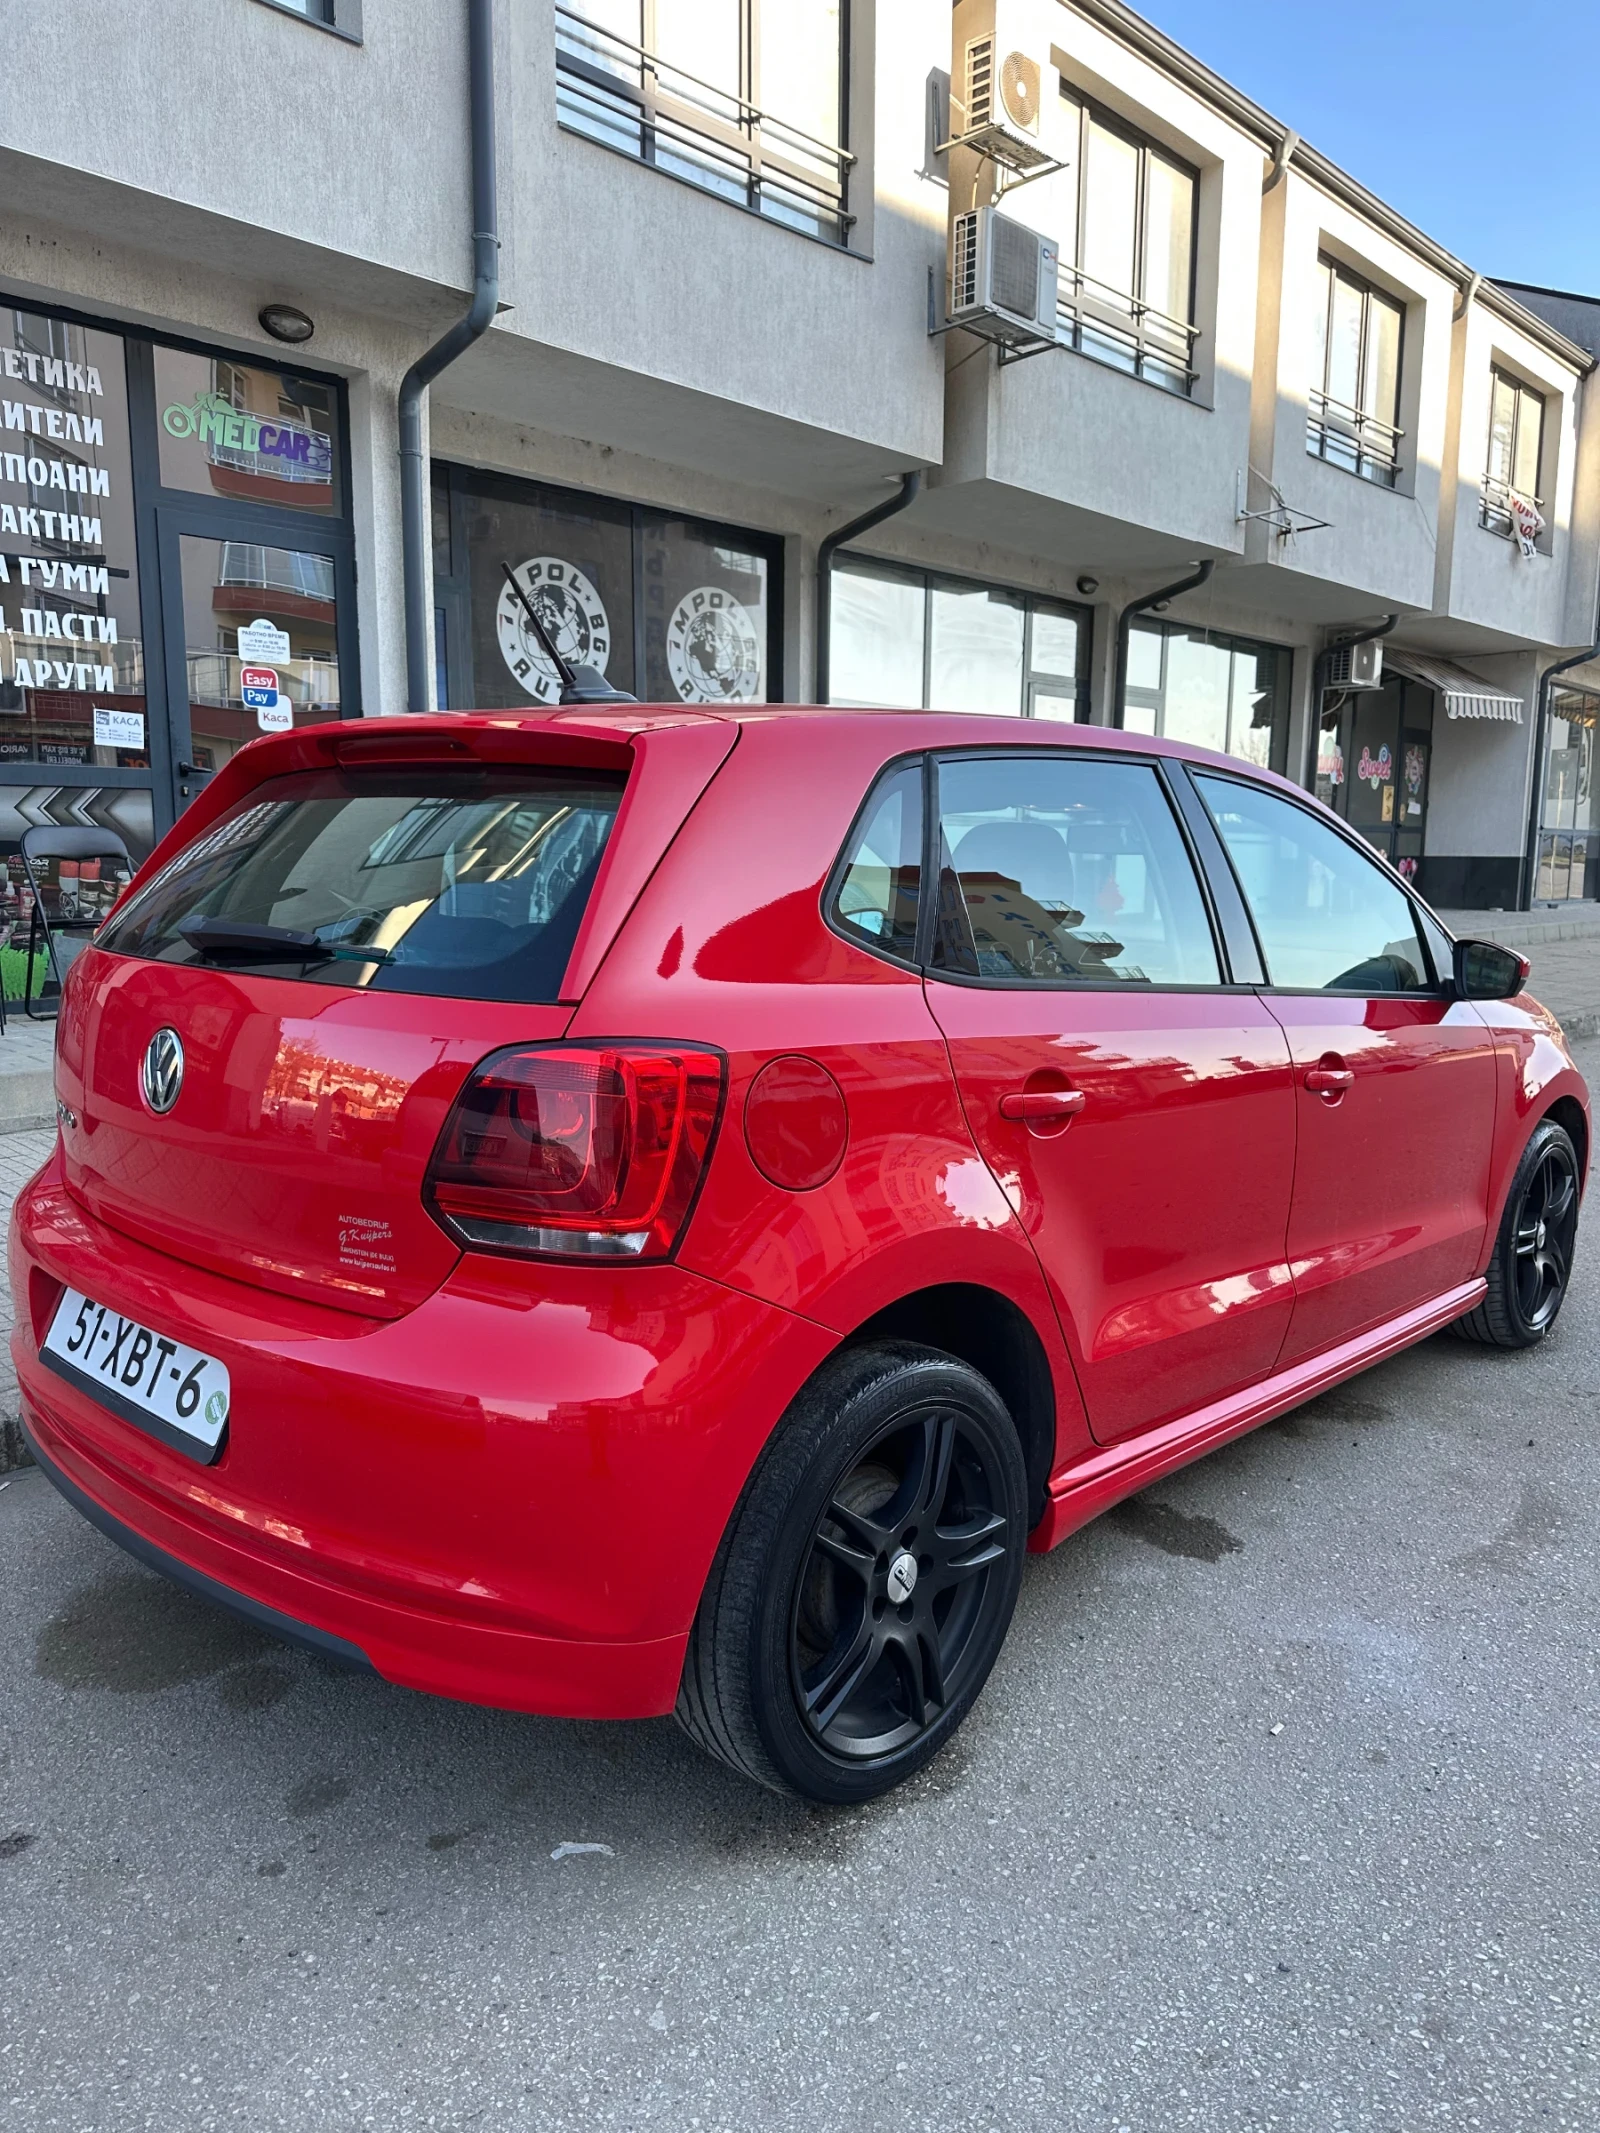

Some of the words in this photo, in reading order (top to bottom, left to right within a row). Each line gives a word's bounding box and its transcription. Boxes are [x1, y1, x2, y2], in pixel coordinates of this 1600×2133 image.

[0, 346, 104, 396] ЕТИКА
[0, 400, 104, 446] ИТЕЛИ
[0, 451, 110, 497] ПОАНИ
[1, 503, 102, 544] АКТНИ
[18, 556, 110, 595] ГУМИ
[20, 608, 118, 645] ПАСТИ
[589, 613, 607, 653] BG
[672, 592, 738, 650] IMPOL
[14, 658, 115, 693] ДРУГИ
[246, 673, 273, 687] Easy
[247, 689, 268, 704] Pay
[338, 1215, 389, 1229] AUTOBEDRIJF
[67, 1298, 208, 1418] 51-XBT-6
